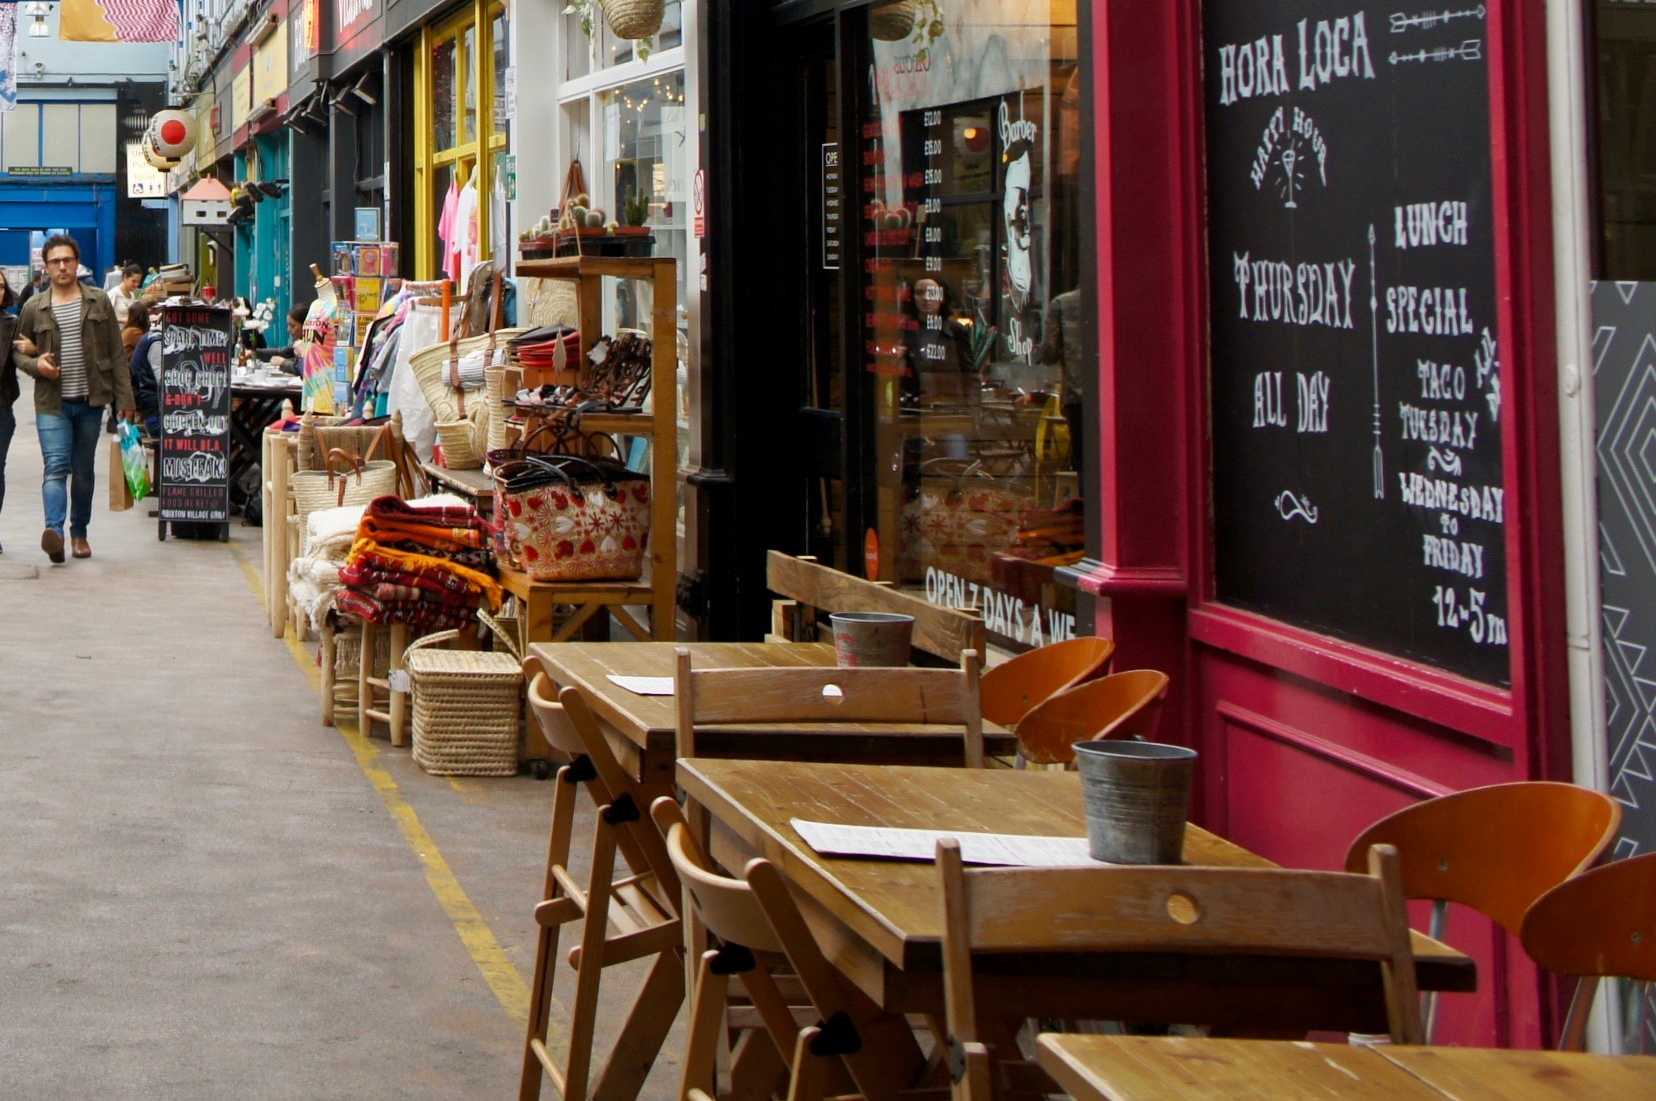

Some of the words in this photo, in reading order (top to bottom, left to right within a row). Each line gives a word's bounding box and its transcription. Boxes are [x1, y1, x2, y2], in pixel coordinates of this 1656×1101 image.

[1218, 33, 1290, 105] HORA
[1297, 10, 1375, 92] LOCA
[998, 91, 1037, 154] Barber
[1250, 106, 1284, 190] HAPPY
[1293, 106, 1327, 187] HOUR
[1394, 201, 1468, 249] LUNCH
[1233, 250, 1356, 329] THURSDAY
[1386, 285, 1473, 336] SPECIAL
[204, 352, 227, 364] WELL
[1008, 317, 1033, 366] Shop
[1253, 371, 1286, 428] ALL
[1297, 370, 1330, 433] DAY
[1417, 358, 1465, 400] TACO
[164, 439, 173, 451] IT
[177, 439, 197, 451] WILL
[1398, 401, 1478, 449] TUESDAY
[1398, 472, 1503, 525] WEDNESDAY
[1422, 534, 1484, 579] FRIDAY
[925, 566, 966, 610] OPEN
[969, 582, 979, 610] 7
[983, 587, 1024, 643] DAYS
[1031, 603, 1044, 648] A
